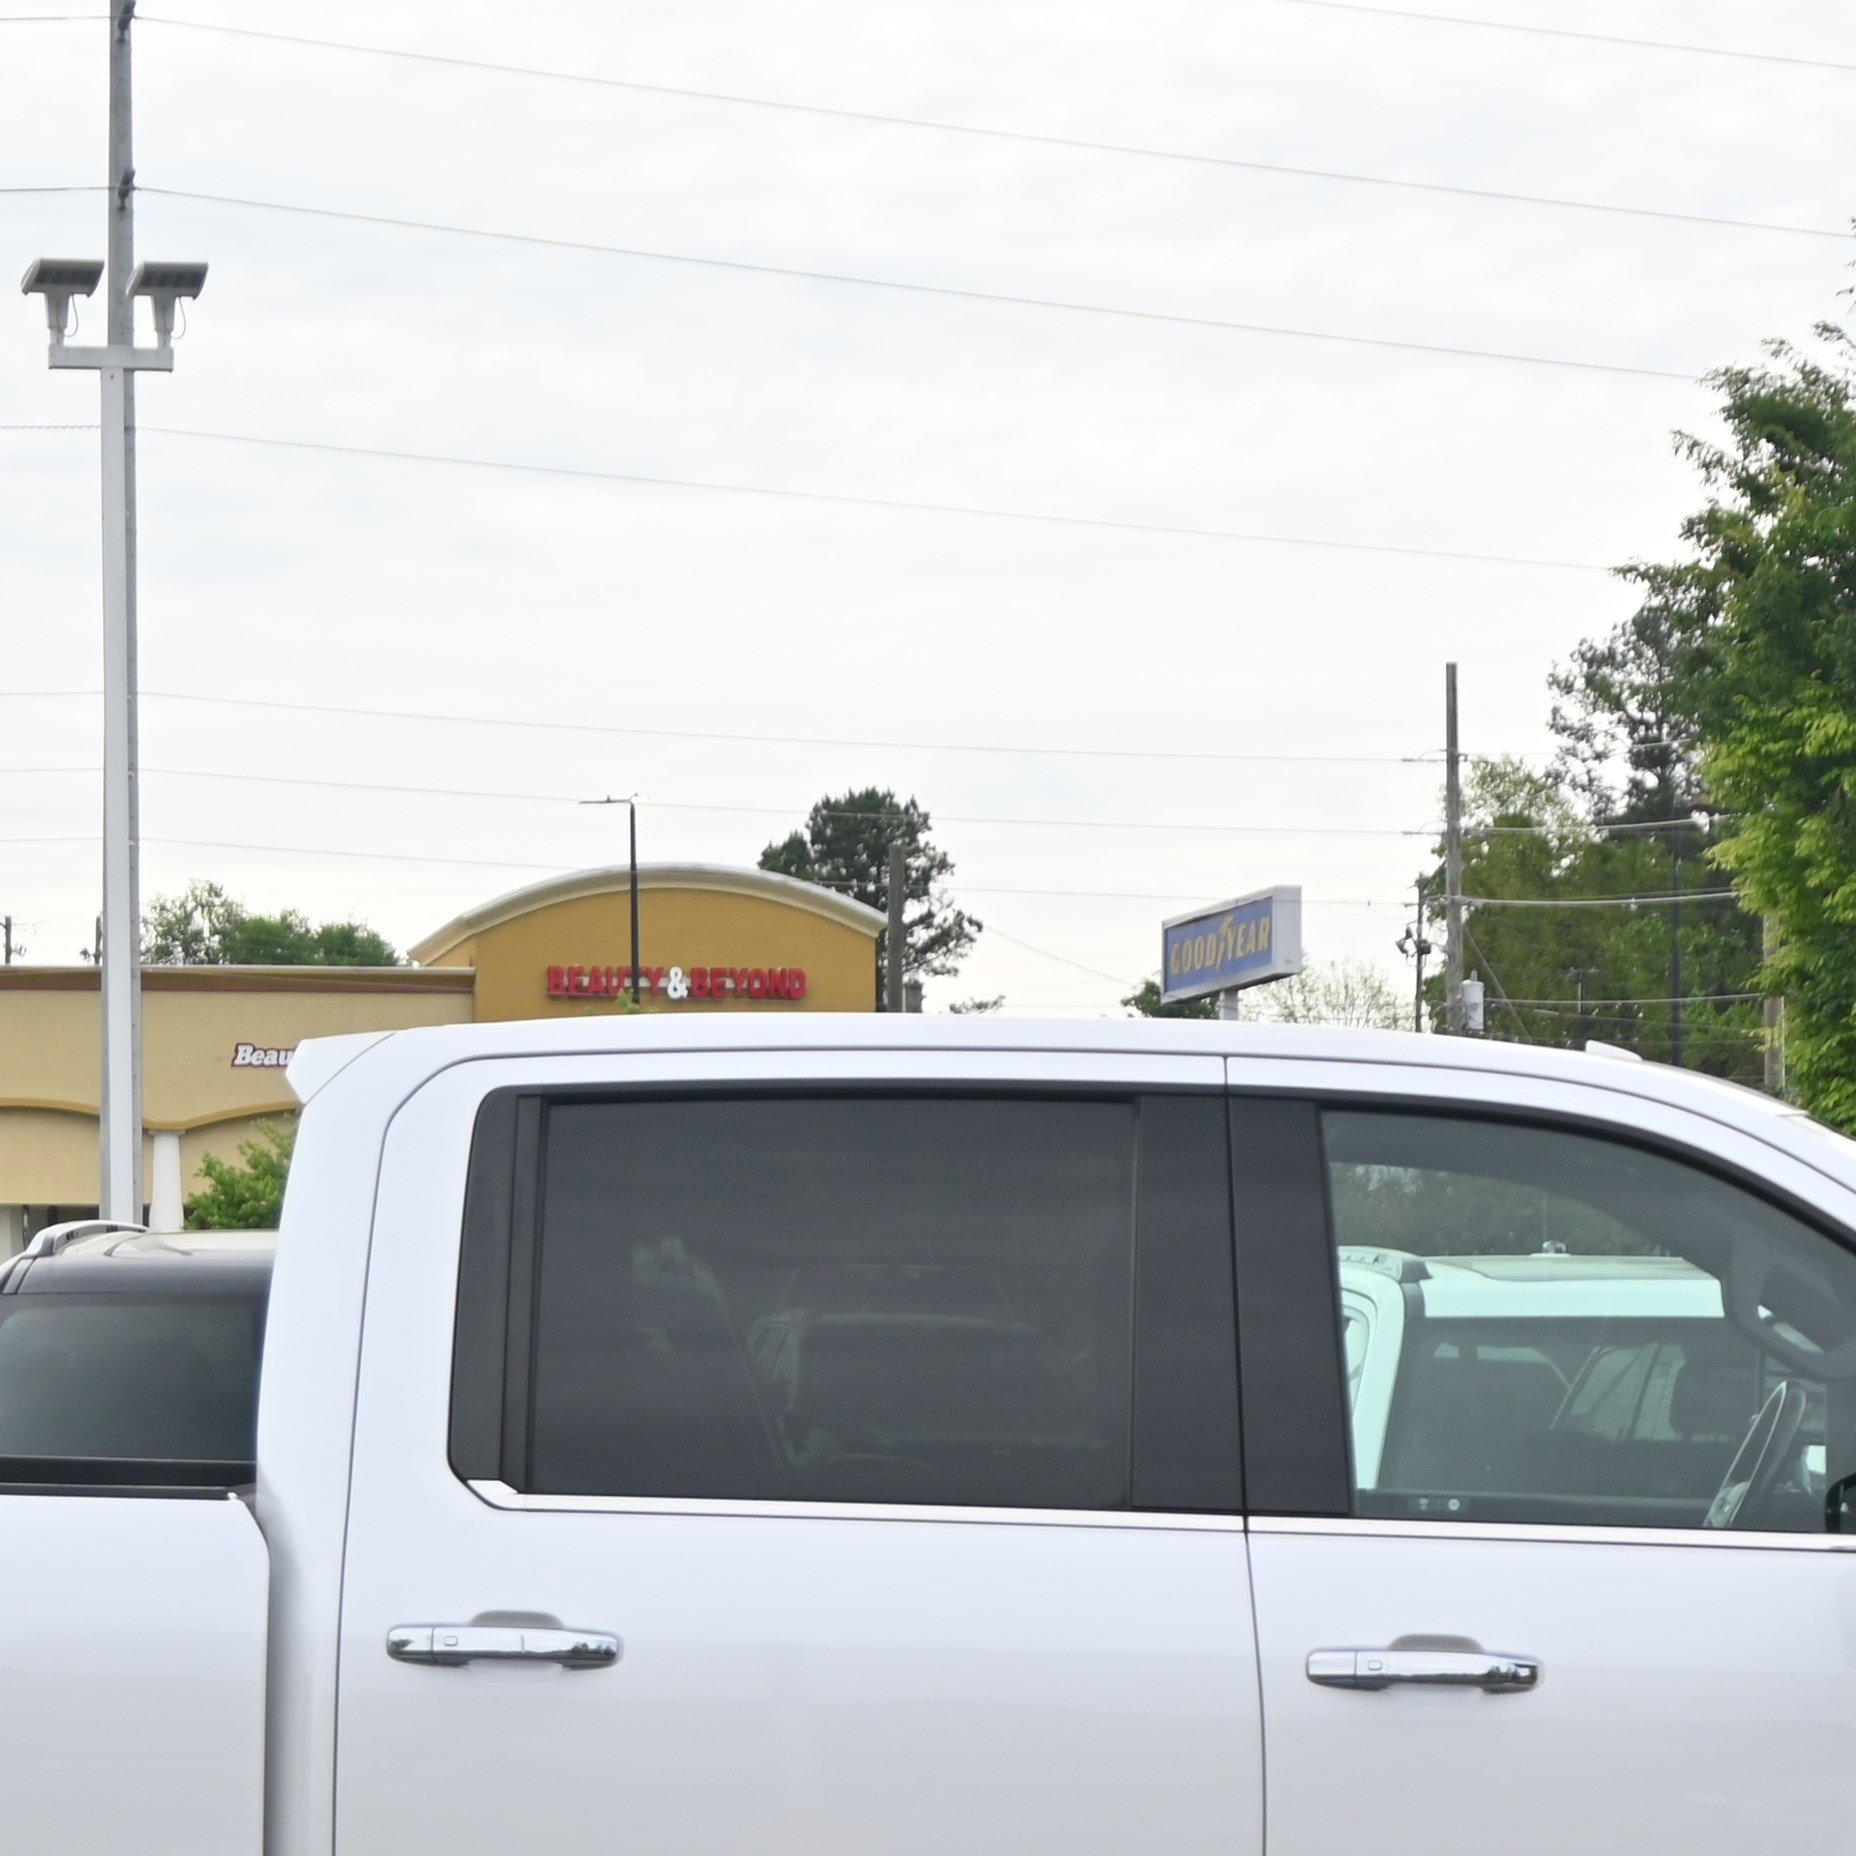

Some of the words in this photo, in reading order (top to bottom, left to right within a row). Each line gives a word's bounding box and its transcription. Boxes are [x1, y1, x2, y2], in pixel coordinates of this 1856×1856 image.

[1170, 915, 1271, 977] GOODYEAR
[667, 966, 689, 999] &
[690, 967, 808, 999] BEYOND
